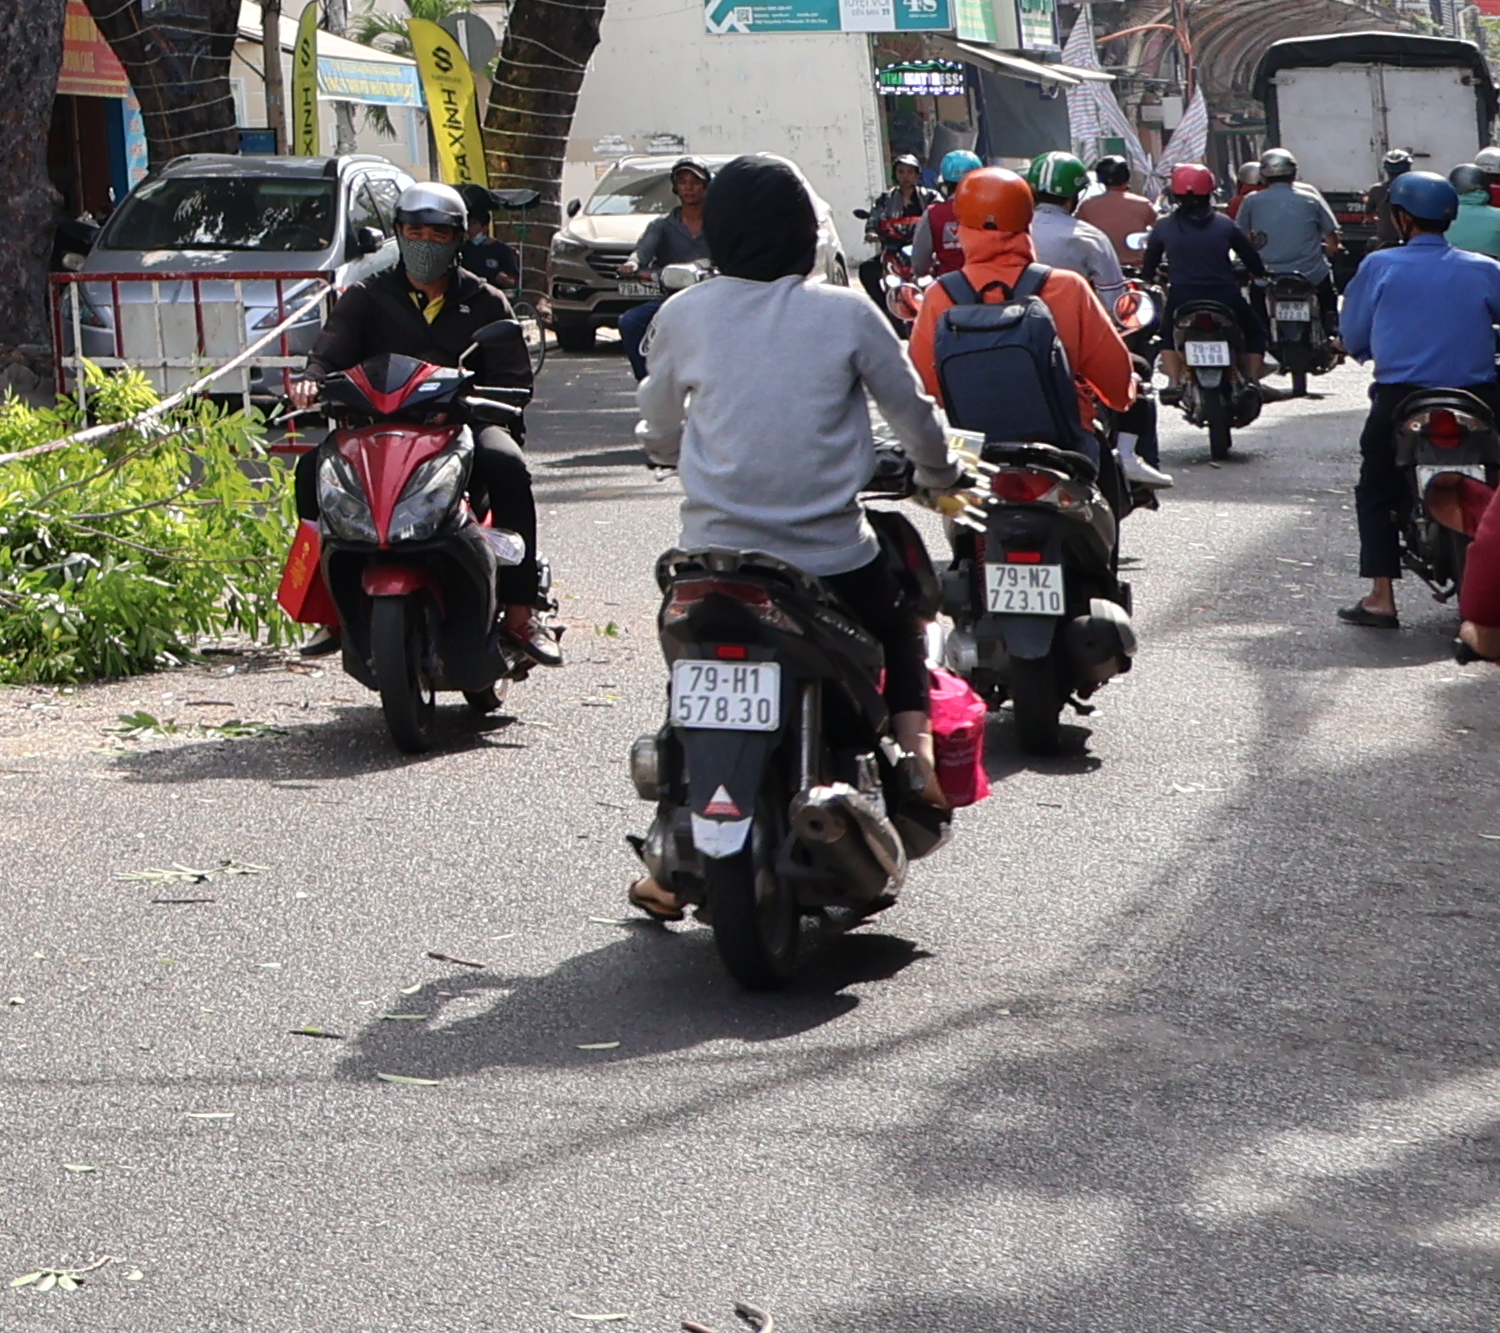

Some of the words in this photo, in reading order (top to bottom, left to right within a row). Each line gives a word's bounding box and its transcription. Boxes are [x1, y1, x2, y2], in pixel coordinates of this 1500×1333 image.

[995, 568, 1052, 590] 79-N2
[990, 588, 1061, 613] 723.10
[688, 665, 761, 696] 79-H1
[678, 695, 771, 725] 578.30
